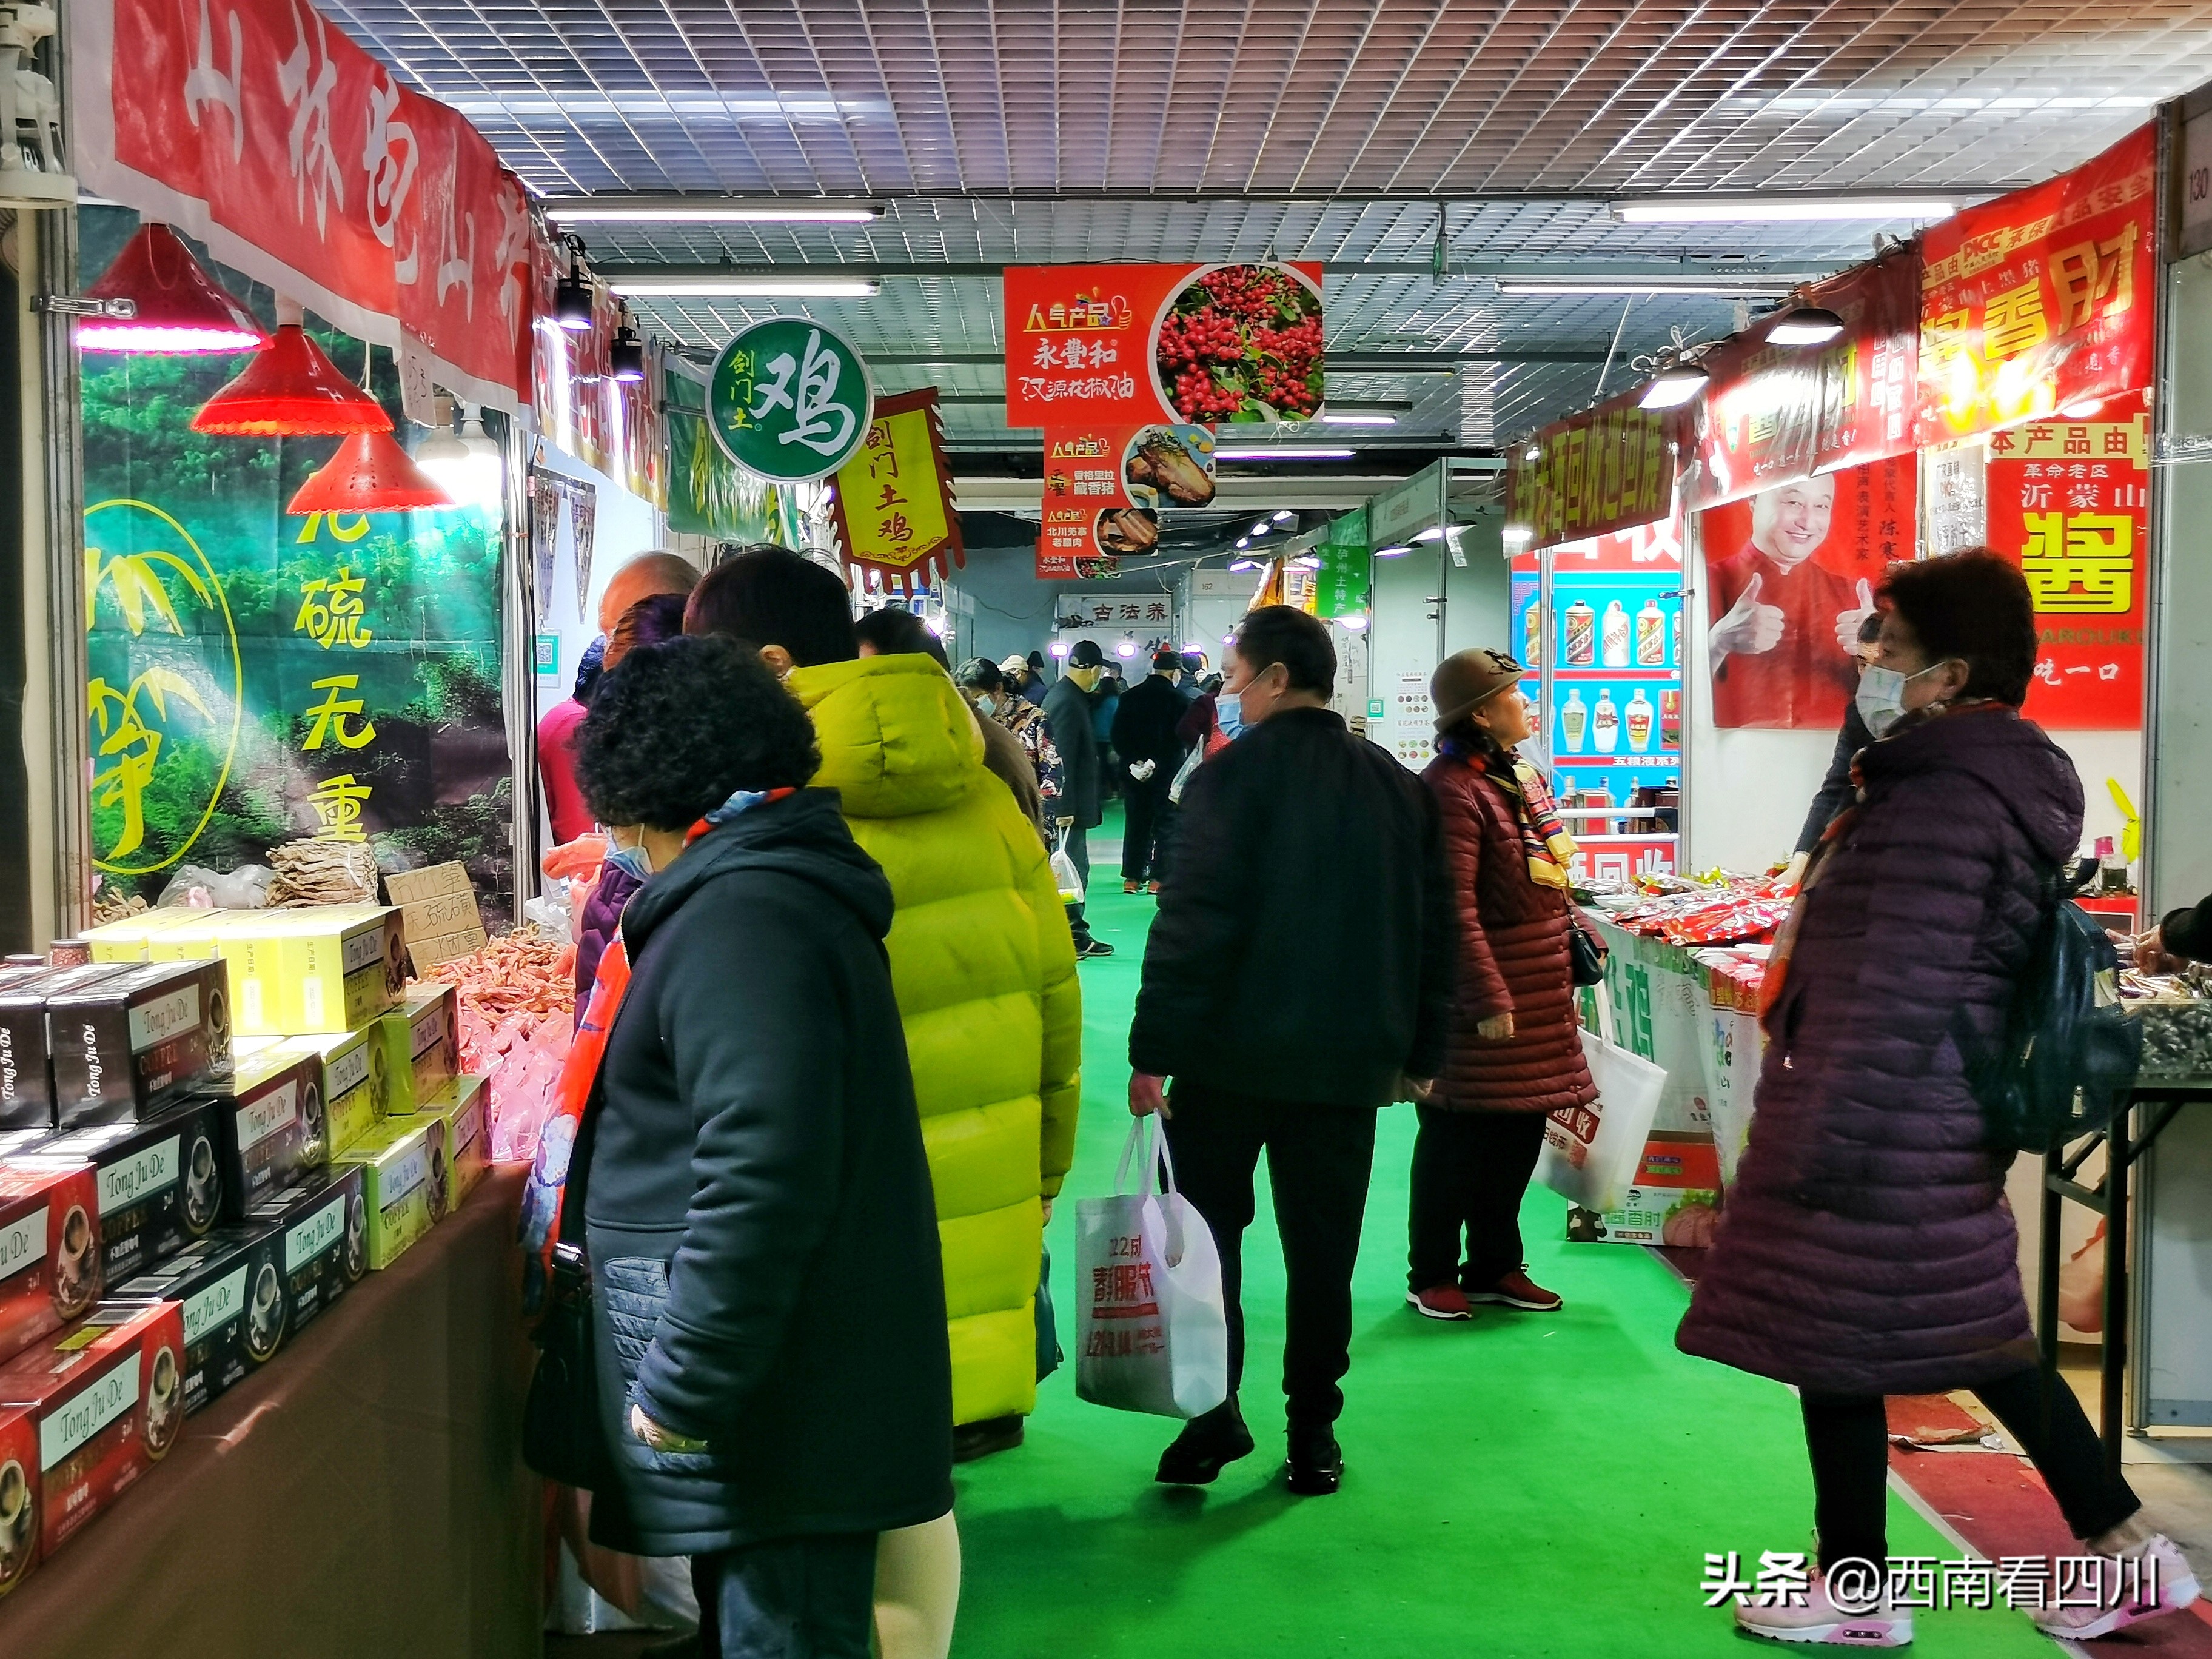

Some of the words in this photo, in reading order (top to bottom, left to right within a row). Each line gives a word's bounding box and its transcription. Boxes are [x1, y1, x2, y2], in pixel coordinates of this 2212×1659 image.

[1963, 229, 2003, 263] PICC
[1026, 303, 1111, 330] 人气产品
[728, 350, 756, 431] 剑门土
[749, 328, 857, 458] 鸡
[1017, 370, 1134, 402] 汉源花椒油
[1991, 427, 2127, 454] 本产品由
[866, 420, 914, 544] 剑门土鸡
[1073, 470, 1115, 480] 香格里拉
[2023, 463, 2109, 479] 革命老区
[1073, 482, 1115, 495] 藏香猪
[2020, 483, 2145, 508] 沂蒙山
[2040, 629, 2143, 646] AROUK
[2034, 659, 2119, 686] 吃一口
[1613, 756, 1680, 766] 五粮液系列
[83, 1025, 96, 1046] De
[84, 1047, 100, 1066] Ju
[86, 1065, 103, 1098] Tong
[107, 1169, 135, 1199] Tong
[135, 1160, 149, 1190] Ju
[150, 1153, 165, 1178] De
[11, 1230, 29, 1259] De
[296, 1227, 315, 1255] Tong
[326, 1212, 336, 1233] De
[201, 1296, 215, 1326] Ju
[216, 1286, 232, 1312] De
[61, 1404, 90, 1443] Tong
[90, 1392, 106, 1429] Ju
[107, 1379, 124, 1405] De
